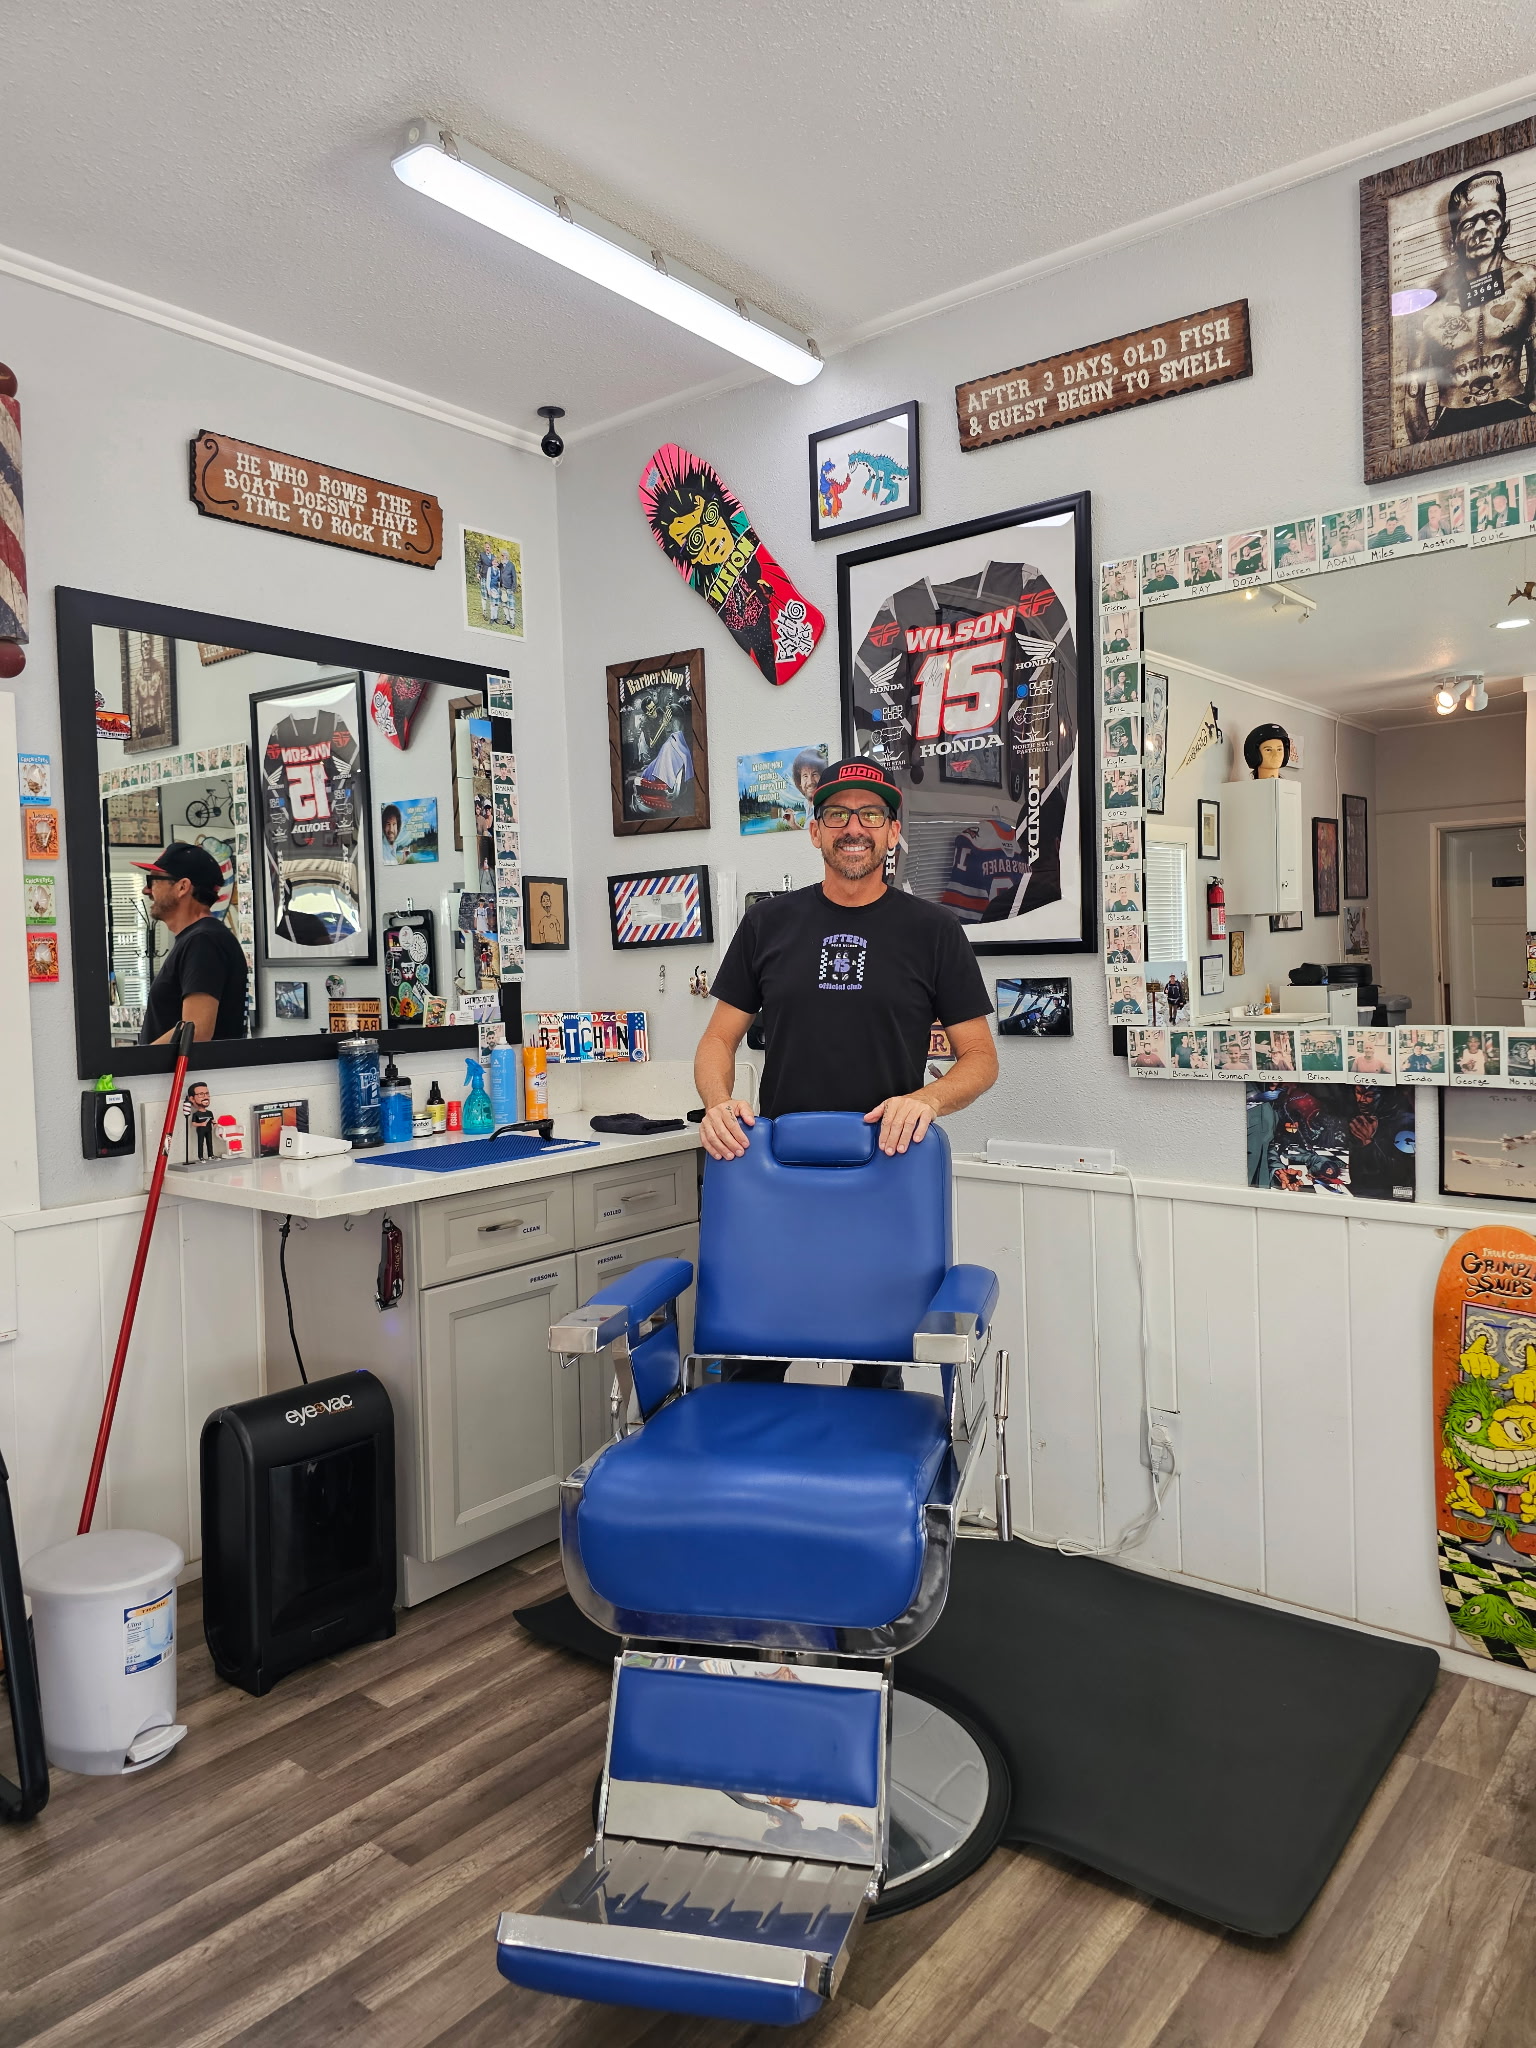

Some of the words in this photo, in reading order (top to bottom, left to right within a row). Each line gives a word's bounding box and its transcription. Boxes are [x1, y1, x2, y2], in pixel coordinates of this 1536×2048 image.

[967, 378, 1032, 414] AFTER
[1043, 371, 1055, 392] 3
[1062, 352, 1119, 386] DAYS,
[1122, 337, 1168, 368] OLD
[1179, 317, 1231, 352] FISH
[968, 417, 983, 437] &
[988, 397, 1048, 431] GUEST
[1056, 377, 1113, 412] BEGIN
[1122, 368, 1150, 394] TO
[1160, 346, 1231, 384] SMELL
[236, 452, 262, 475] HE
[268, 460, 309, 487] WHO
[319, 475, 368, 503] ROWS
[376, 492, 412, 516] THE
[224, 468, 280, 499] BOAT
[292, 487, 365, 521] DOESN'T
[371, 508, 418, 536] HAVE
[241, 493, 290, 523] TIME
[299, 508, 324, 530] TO
[331, 516, 375, 543] ROCK
[381, 529, 402, 550] IT.
[1371, 549, 1395, 561] Miles
[1326, 555, 1357, 570] ADAM
[709, 535, 756, 605] VISION
[1276, 567, 1312, 579] Warren
[1191, 584, 1211, 596] RAY
[905, 604, 1017, 654] WILSON
[1015, 657, 1058, 671] HONDA
[626, 670, 662, 696] Barber
[661, 668, 684, 689] Shop
[869, 683, 905, 694] HONDA
[1029, 680, 1054, 690] QUAD
[914, 638, 1007, 741] 15
[1029, 687, 1053, 697] LOCK
[882, 712, 903, 721] LOCK
[920, 734, 1004, 758] HONDA
[1028, 766, 1041, 866] HONDA
[822, 933, 868, 949] FIFTEEN
[833, 958, 851, 973] 15
[818, 982, 846, 991] official
[1136, 1067, 1159, 1077] RYAN
[1307, 1073, 1331, 1081] Brian
[1354, 1075, 1378, 1085] Greg
[1455, 1073, 1490, 1085] George
[603, 1208, 622, 1218] SOILED
[522, 1225, 541, 1234] CLEAN
[596, 1253, 623, 1265] PERSONAL
[529, 1271, 559, 1283] PERSONAL
[1479, 1275, 1533, 1297] SNIPS
